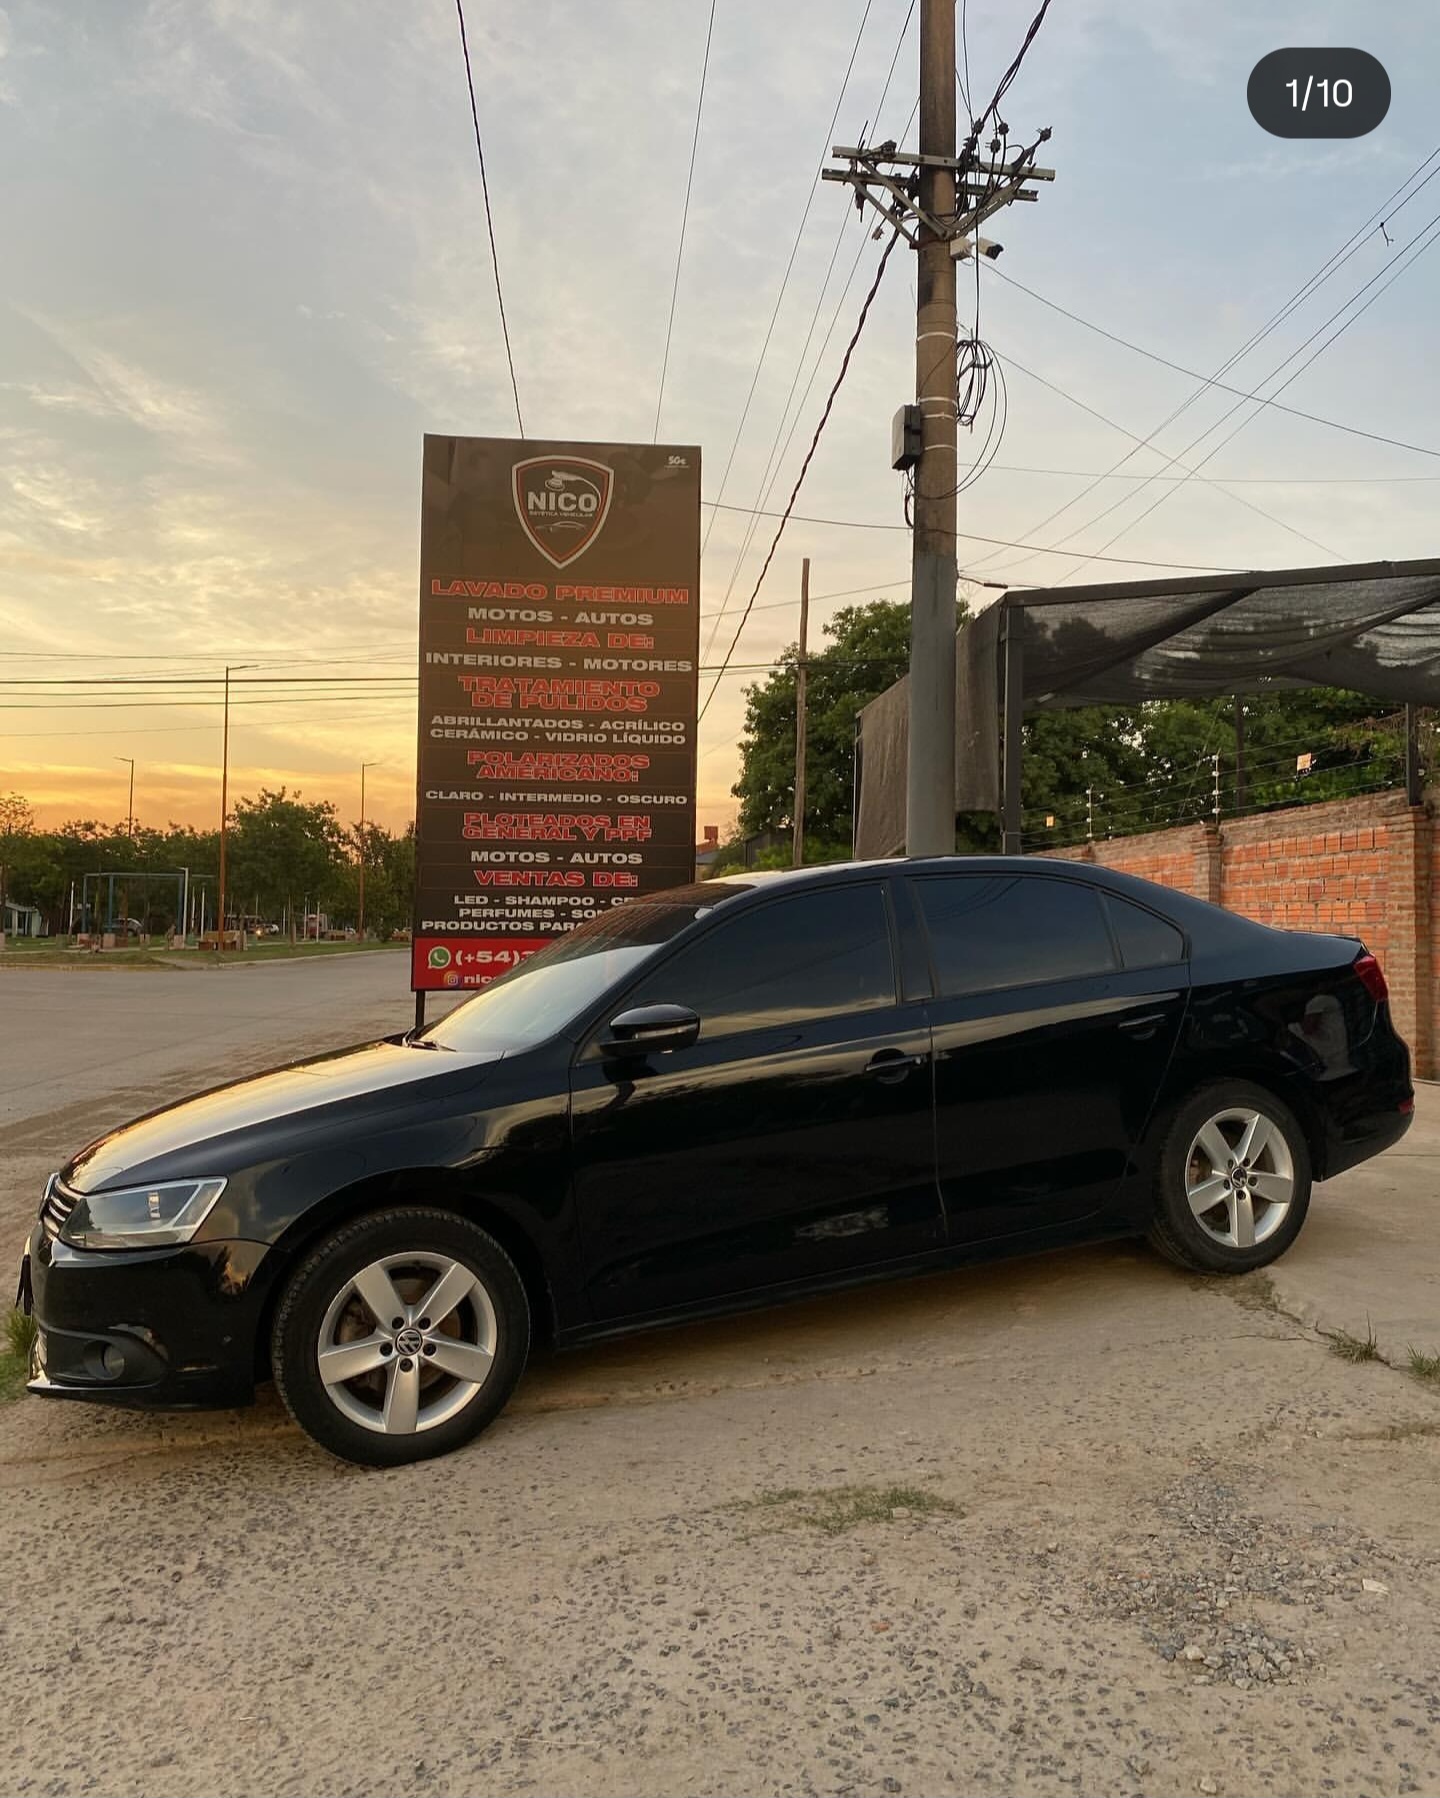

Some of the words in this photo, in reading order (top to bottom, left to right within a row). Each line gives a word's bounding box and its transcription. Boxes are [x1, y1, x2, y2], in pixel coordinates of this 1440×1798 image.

[527, 491, 598, 513] NICO
[431, 579, 548, 600] LAVADO
[555, 585, 689, 605] PREMIUM
[468, 607, 553, 622] MOTOS
[575, 612, 654, 625] AUTOS
[466, 627, 600, 648] LIMPIEZA
[607, 632, 655, 649] DE:
[425, 652, 562, 669] INTERIORES
[583, 658, 692, 672] MOTORES
[457, 675, 660, 697] TRATAMIENTO
[472, 692, 513, 709] DE
[519, 693, 648, 712] PULIDOS
[431, 715, 584, 729] ABRILLANTADOS
[599, 719, 685, 731] ACRÍLICO
[430, 727, 529, 741] CERÁMICO
[545, 732, 607, 743] VIDRIO
[612, 732, 686, 745] LÍQUIDO
[467, 750, 650, 769] POLARIZADOS
[425, 790, 484, 801] CLARO
[499, 792, 602, 803] INTERMEDIO
[617, 794, 688, 805] OSCURO
[463, 812, 611, 828] PLOTEADOS
[617, 815, 650, 829] EN
[462, 825, 577, 840] GENERAL
[581, 827, 600, 841] Y
[605, 828, 652, 842] PPF
[471, 850, 551, 863] MOTOS
[570, 852, 643, 864] AUTOS
[473, 870, 586, 887] VENTAS
[592, 871, 638, 887] DE:
[454, 895, 489, 905] LED
[505, 896, 595, 906] SHAMPOO
[458, 908, 555, 919] PERFUMES
[421, 920, 534, 931] PRODUCTOS
[464, 974, 497, 984] nic
